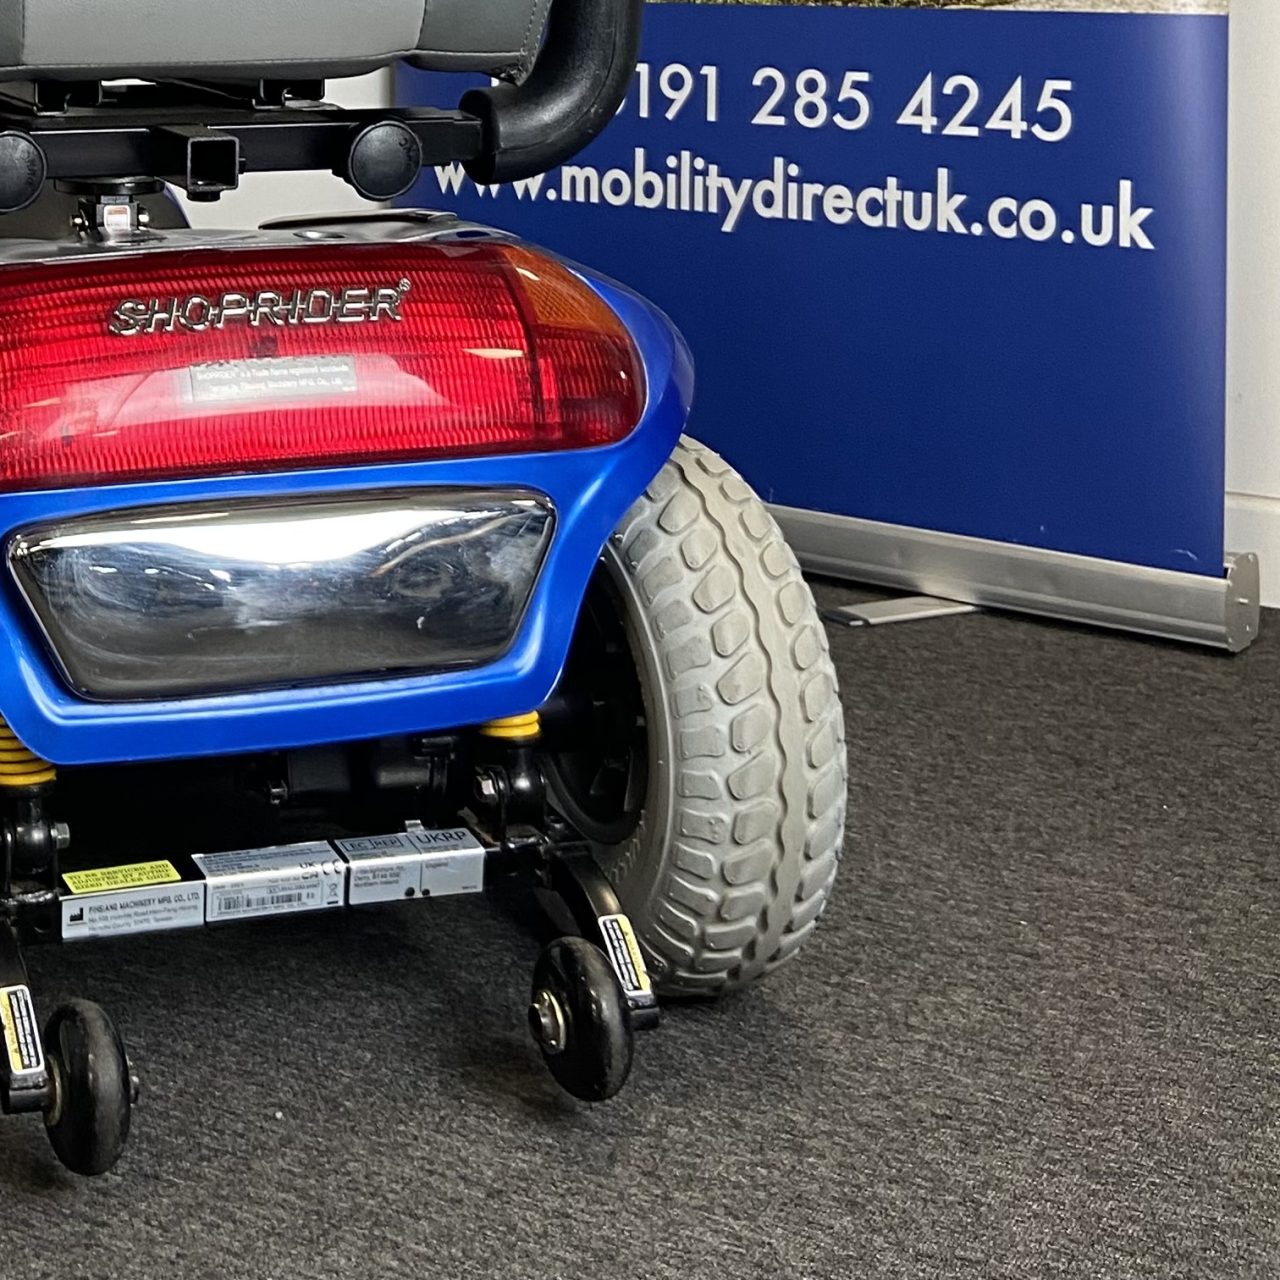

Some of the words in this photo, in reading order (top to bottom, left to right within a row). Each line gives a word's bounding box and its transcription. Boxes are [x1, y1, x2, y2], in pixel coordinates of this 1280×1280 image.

[615, 62, 718, 122] 191
[750, 67, 871, 130] 285
[896, 71, 1073, 142] 4245
[415, 830, 467, 844] UKRP
